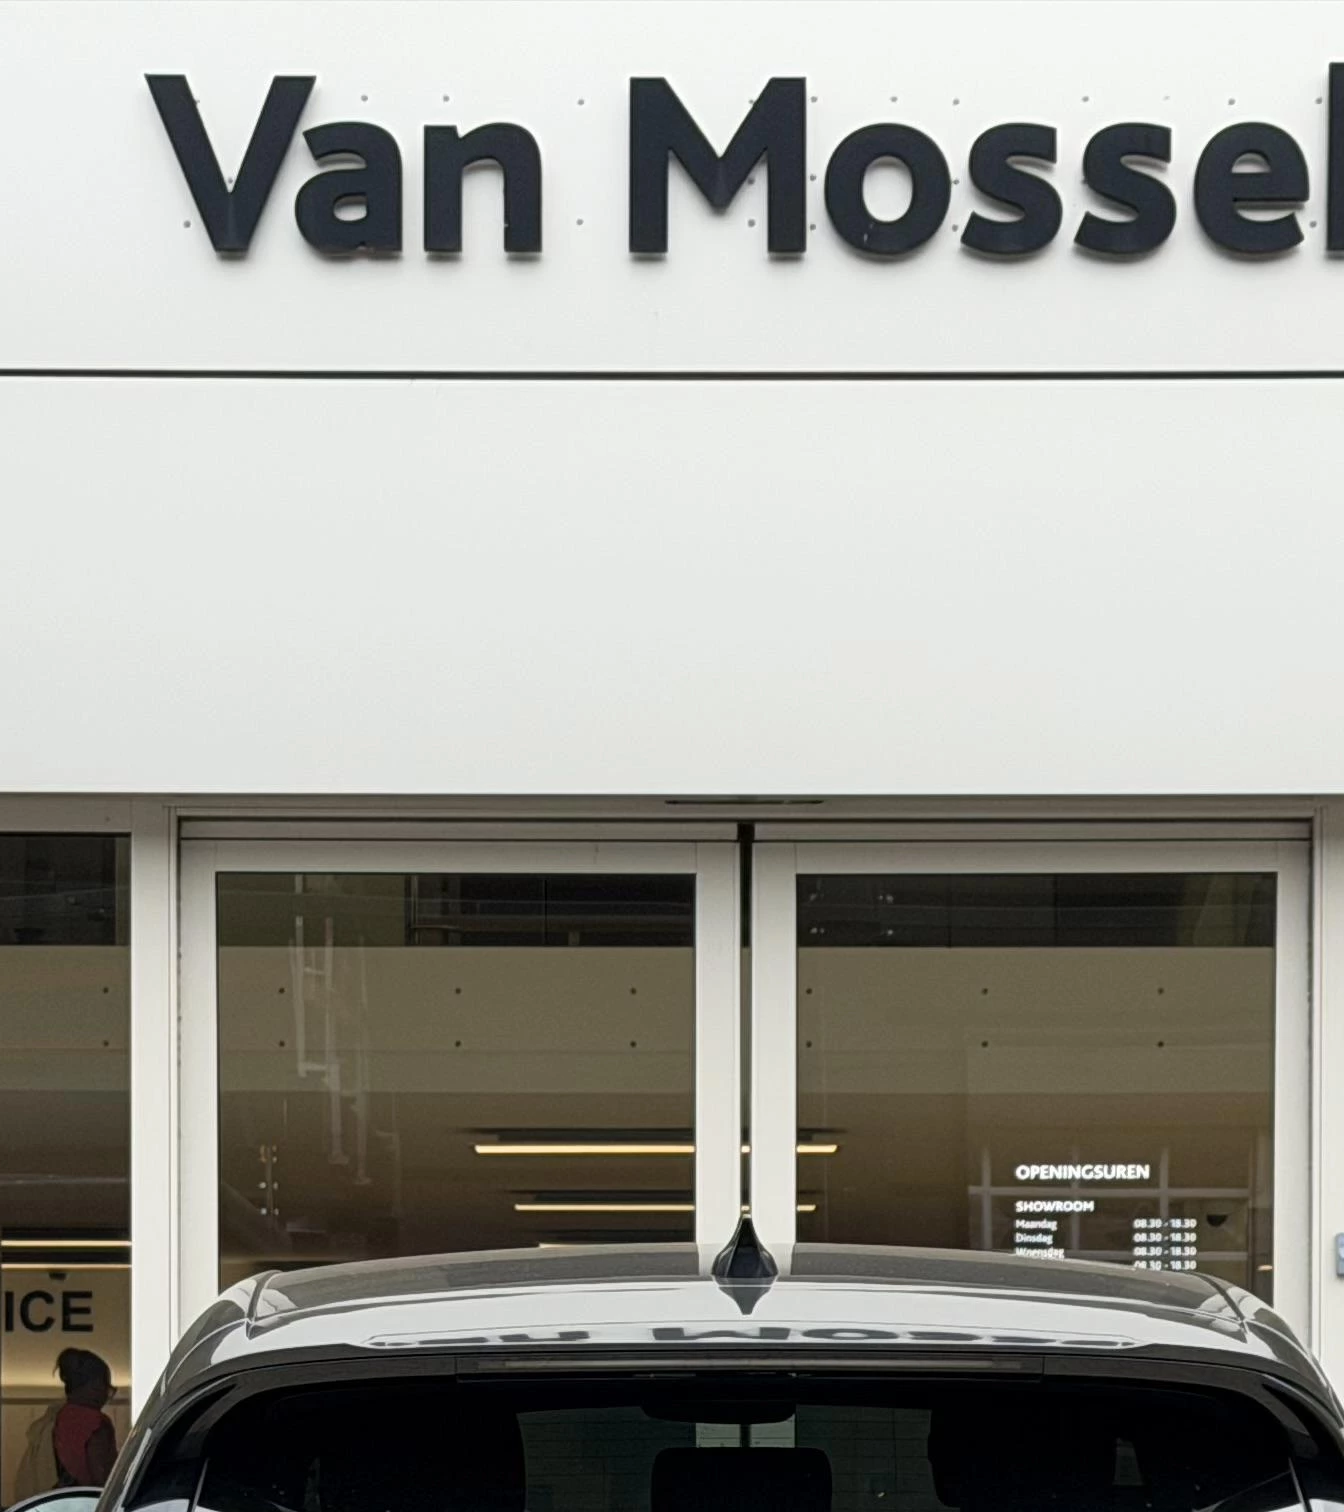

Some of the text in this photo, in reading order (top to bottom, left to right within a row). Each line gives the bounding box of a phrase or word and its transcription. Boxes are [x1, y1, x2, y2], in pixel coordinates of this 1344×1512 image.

[144, 74, 544, 257] Van
[1015, 1164, 1150, 1180] OPENINGSUREN
[1015, 1201, 1095, 1212] SHOWROOM
[1015, 1219, 1058, 1231] Maandag
[1133, 1218, 1162, 1229] 08.30
[1015, 1232, 1053, 1245] Dinsdag
[1133, 1232, 1162, 1242] 08.30
[1133, 1246, 1162, 1257] 08.30
